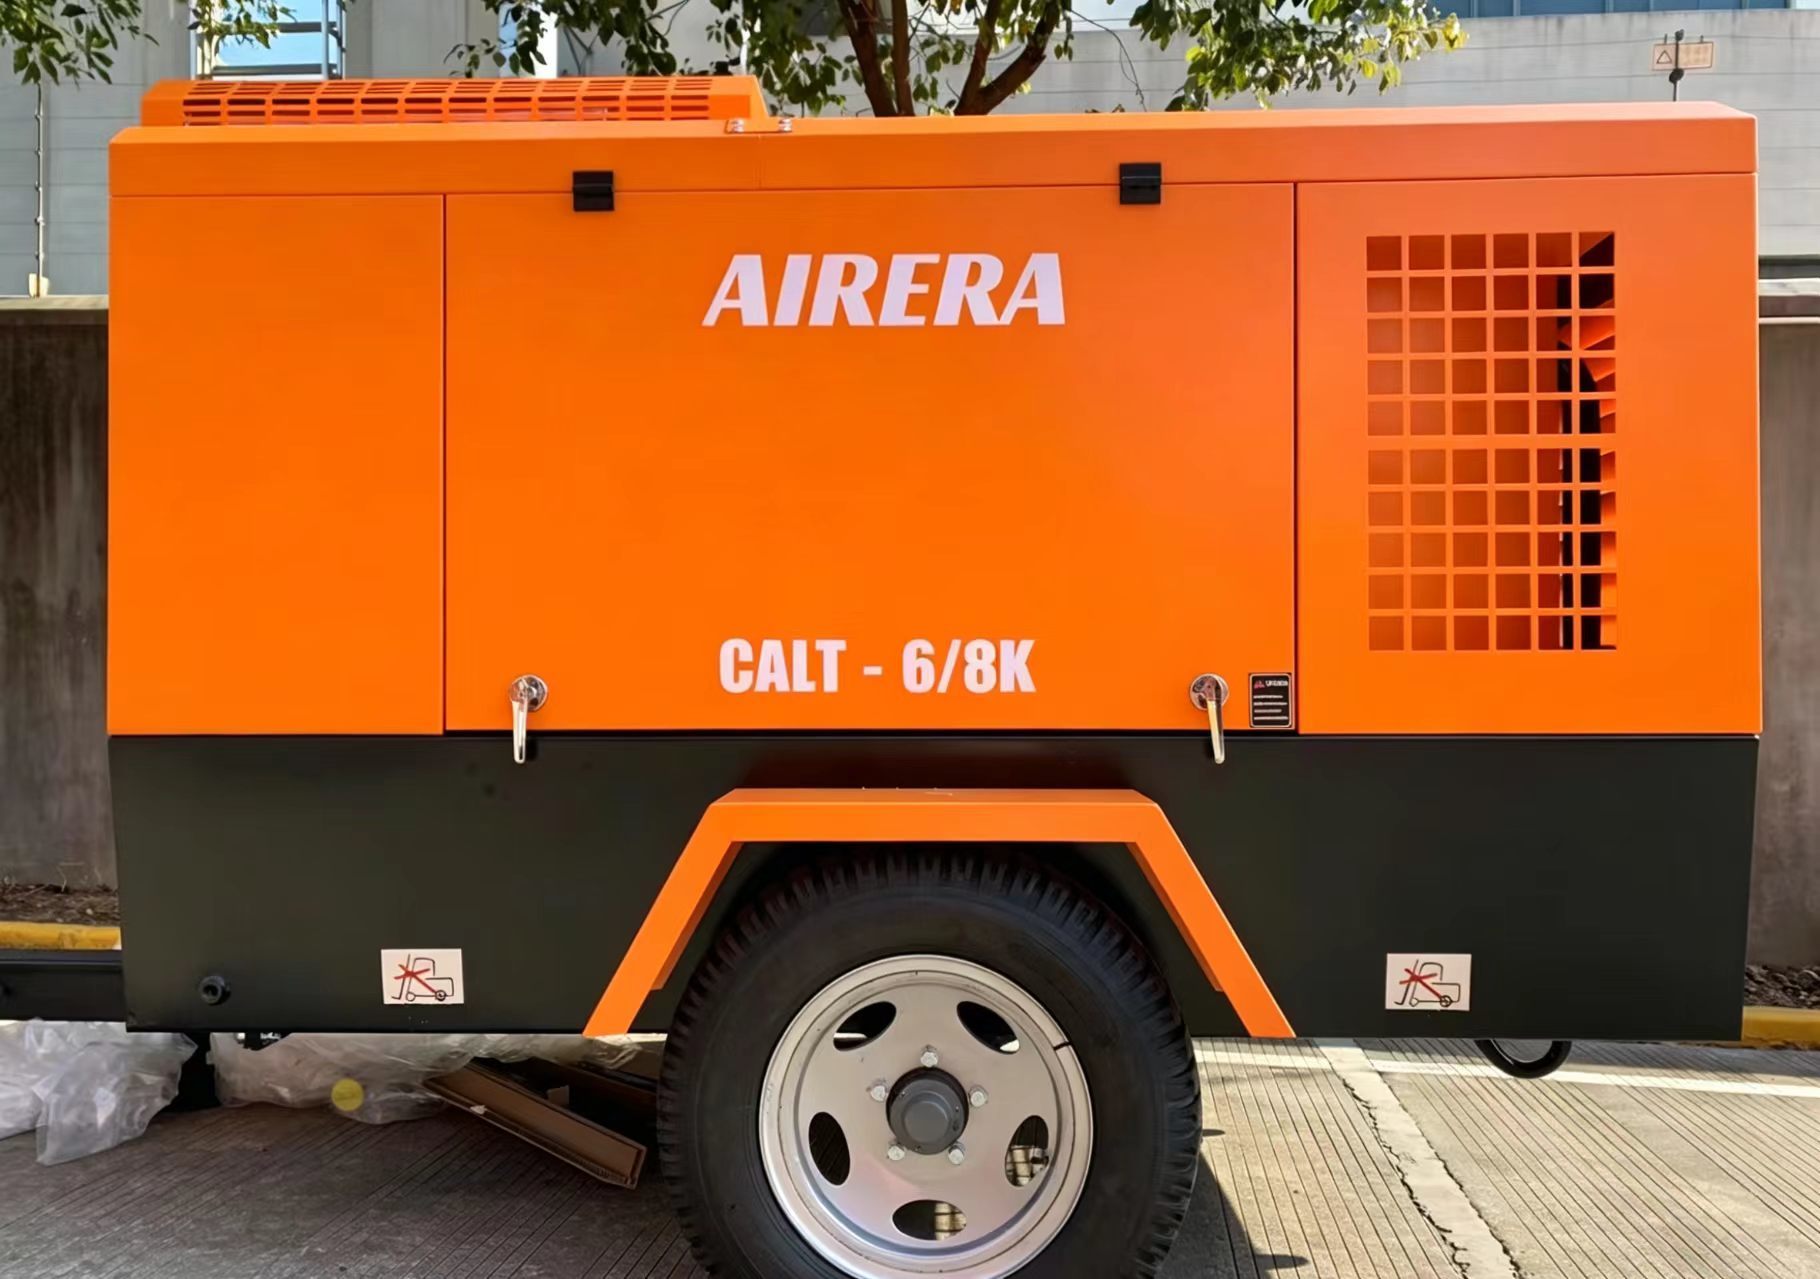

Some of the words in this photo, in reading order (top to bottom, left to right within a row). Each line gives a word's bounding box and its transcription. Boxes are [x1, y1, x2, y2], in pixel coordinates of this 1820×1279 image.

[703, 253, 1065, 326] AIRERA
[720, 639, 846, 693] CALT
[903, 639, 1035, 693] 6/8K
